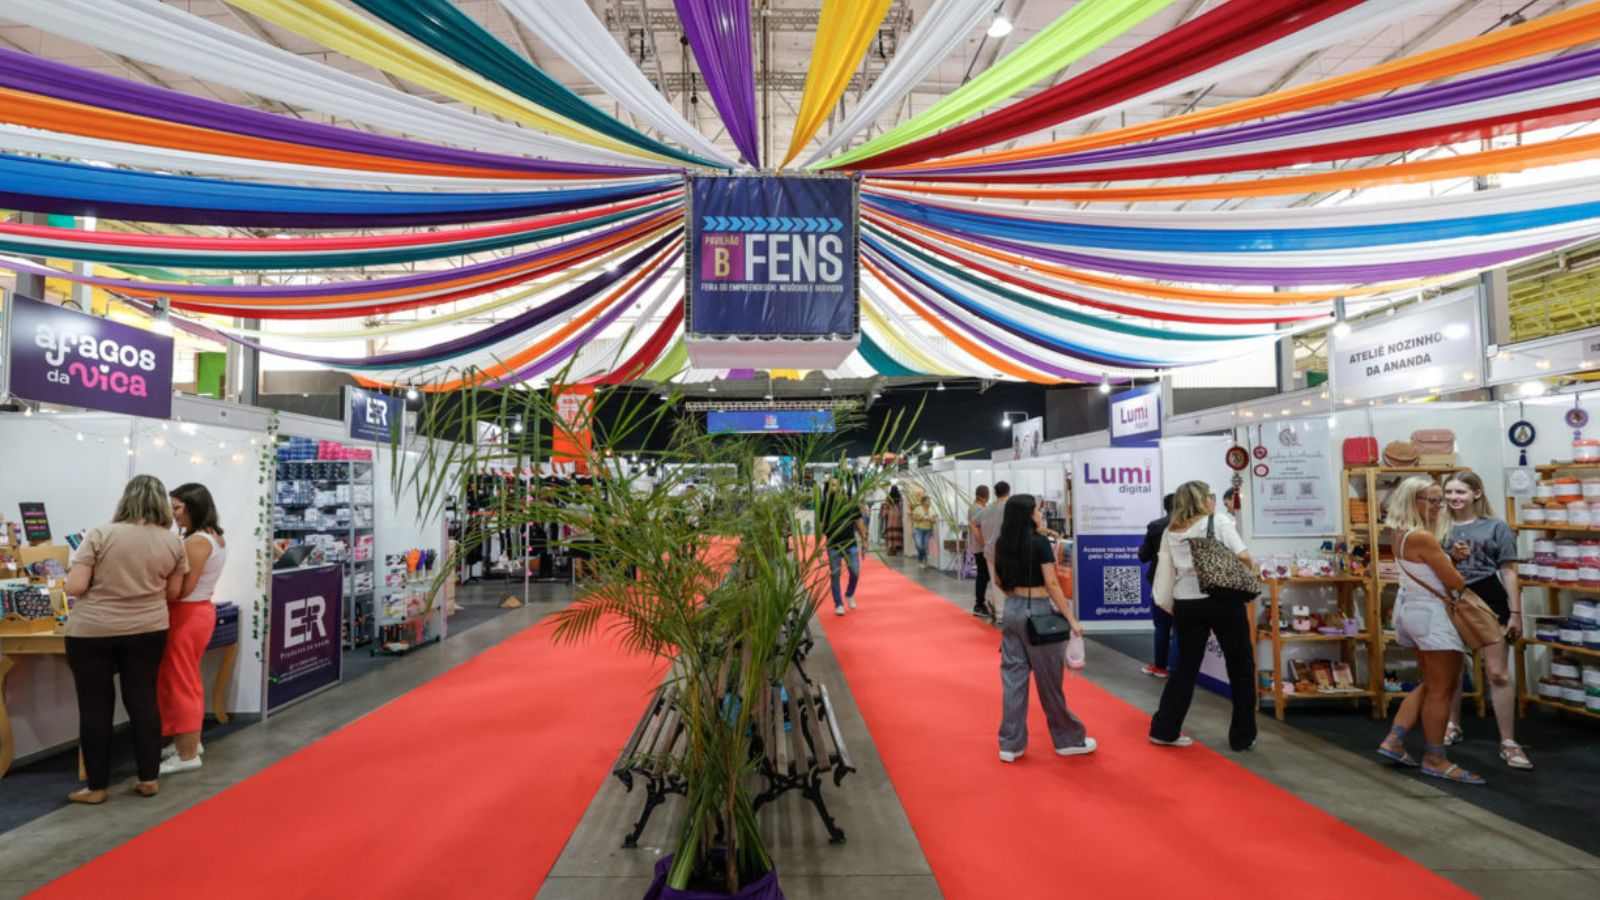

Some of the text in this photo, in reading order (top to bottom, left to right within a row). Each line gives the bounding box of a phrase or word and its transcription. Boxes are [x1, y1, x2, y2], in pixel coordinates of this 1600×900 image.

[705, 234, 739, 245] PAVILHÃO
[714, 247, 730, 277] B
[745, 234, 843, 282] FENS
[701, 283, 717, 291] FEIRA
[1388, 332, 1447, 354] NOZINHO
[1366, 353, 1432, 376] DA ANANDA
[47, 369, 70, 384] da
[1120, 405, 1148, 424] Lumi
[1084, 462, 1151, 485] Lumi
[1119, 485, 1151, 495] digital
